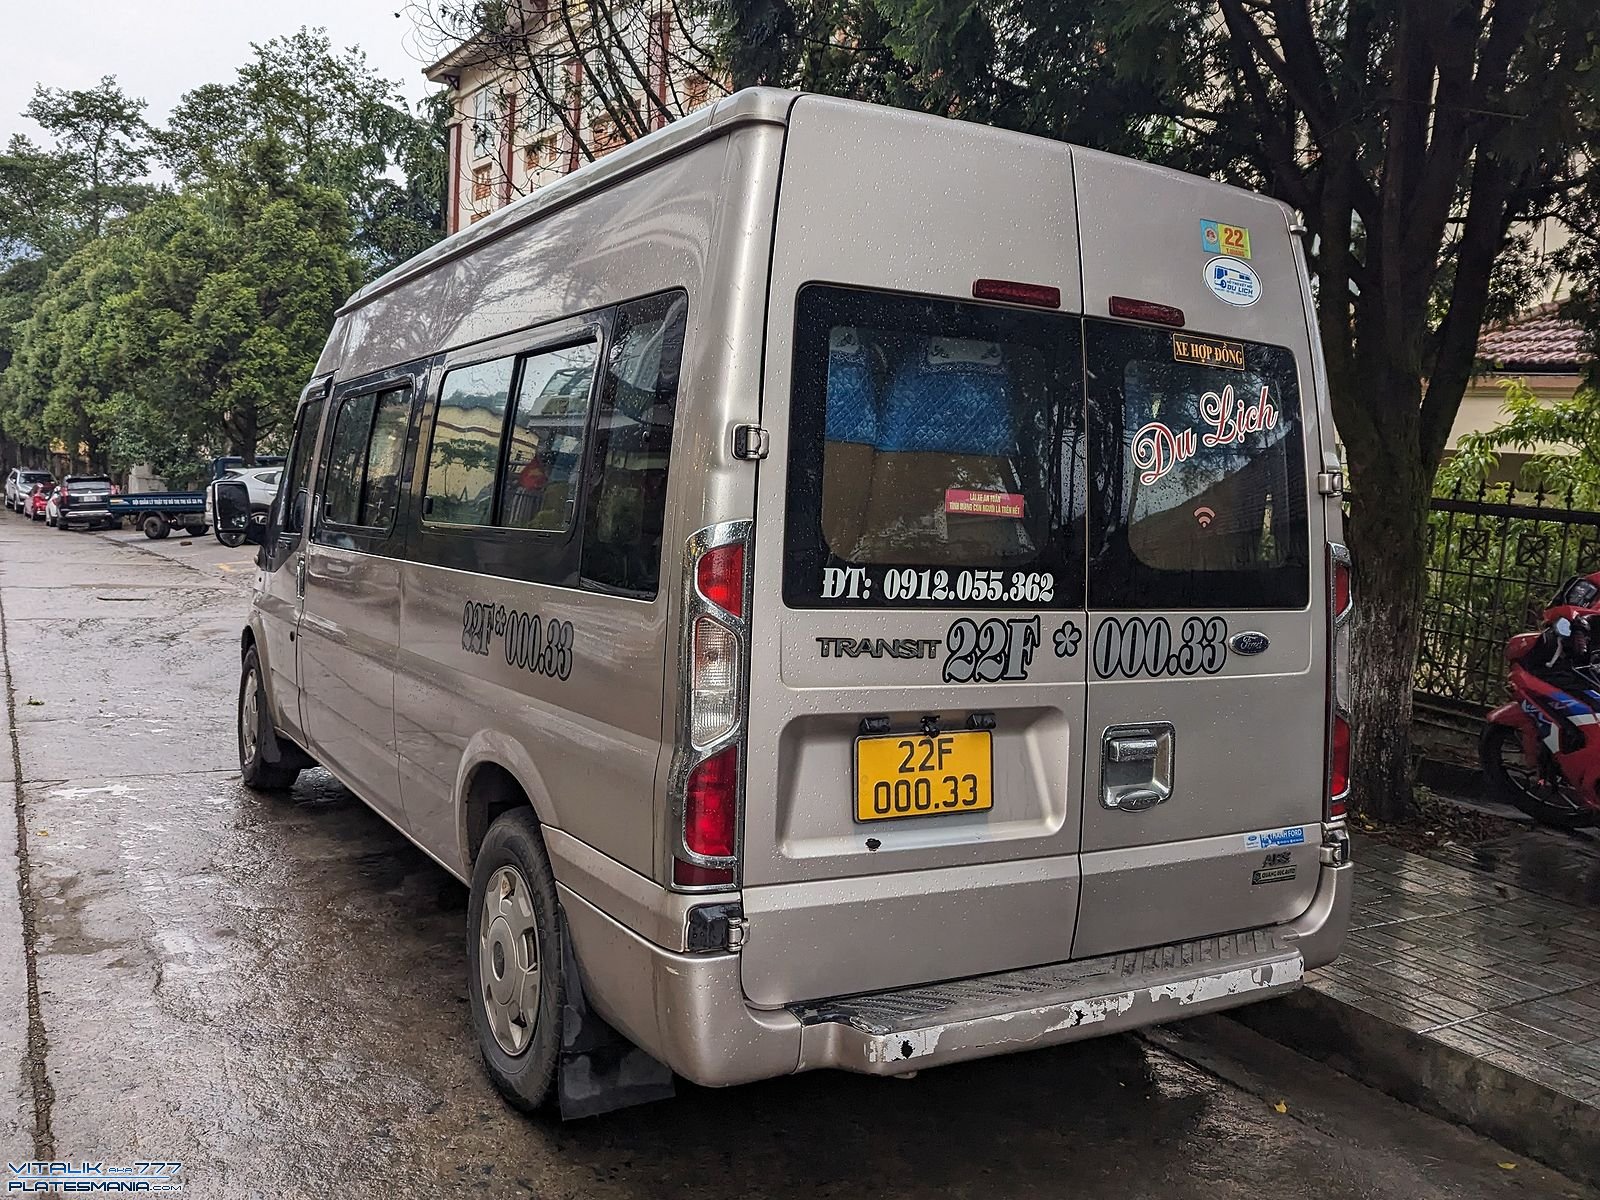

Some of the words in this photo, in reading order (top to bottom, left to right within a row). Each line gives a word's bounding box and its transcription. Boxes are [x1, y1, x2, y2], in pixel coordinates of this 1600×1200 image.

[1224, 227, 1245, 248] 22
[1175, 341, 1190, 357] XE
[1190, 343, 1213, 363] HỢP
[1214, 342, 1243, 365] ĐỒNG
[1131, 421, 1198, 486] Du
[1200, 384, 1280, 448] Lịch
[820, 566, 872, 599] ĐT:
[884, 568, 1055, 602] 0912.055.362
[461, 600, 496, 657] 22F
[505, 609, 575, 682] 000.33
[816, 636, 942, 659] TRANSIT
[942, 614, 1041, 683] 22F
[1093, 616, 1228, 680] 000.33
[1239, 634, 1264, 651] Ford
[898, 737, 954, 774] 22F
[874, 773, 978, 815] 000.33
[1288, 828, 1303, 838] FORD
